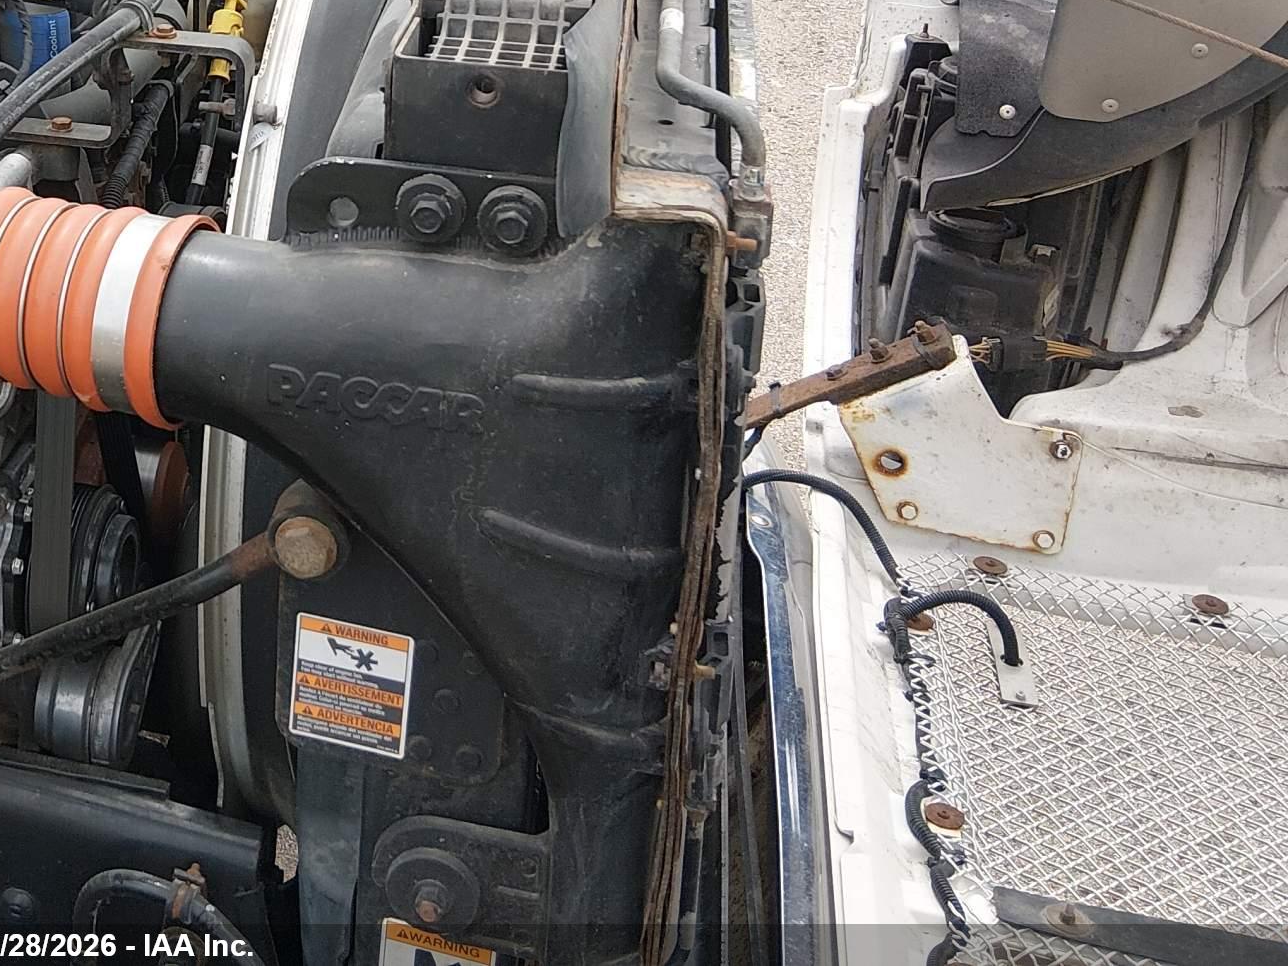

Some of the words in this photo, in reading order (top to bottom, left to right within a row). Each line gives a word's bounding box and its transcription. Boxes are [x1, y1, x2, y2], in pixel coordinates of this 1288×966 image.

[49, 19, 58, 58] Coolant
[267, 363, 486, 432] PACCAR
[335, 624, 390, 646] WARNING
[314, 677, 402, 706] AVERTISSEMENT
[317, 708, 394, 735] ADVERTENCIA
[410, 931, 480, 958] WARNING
